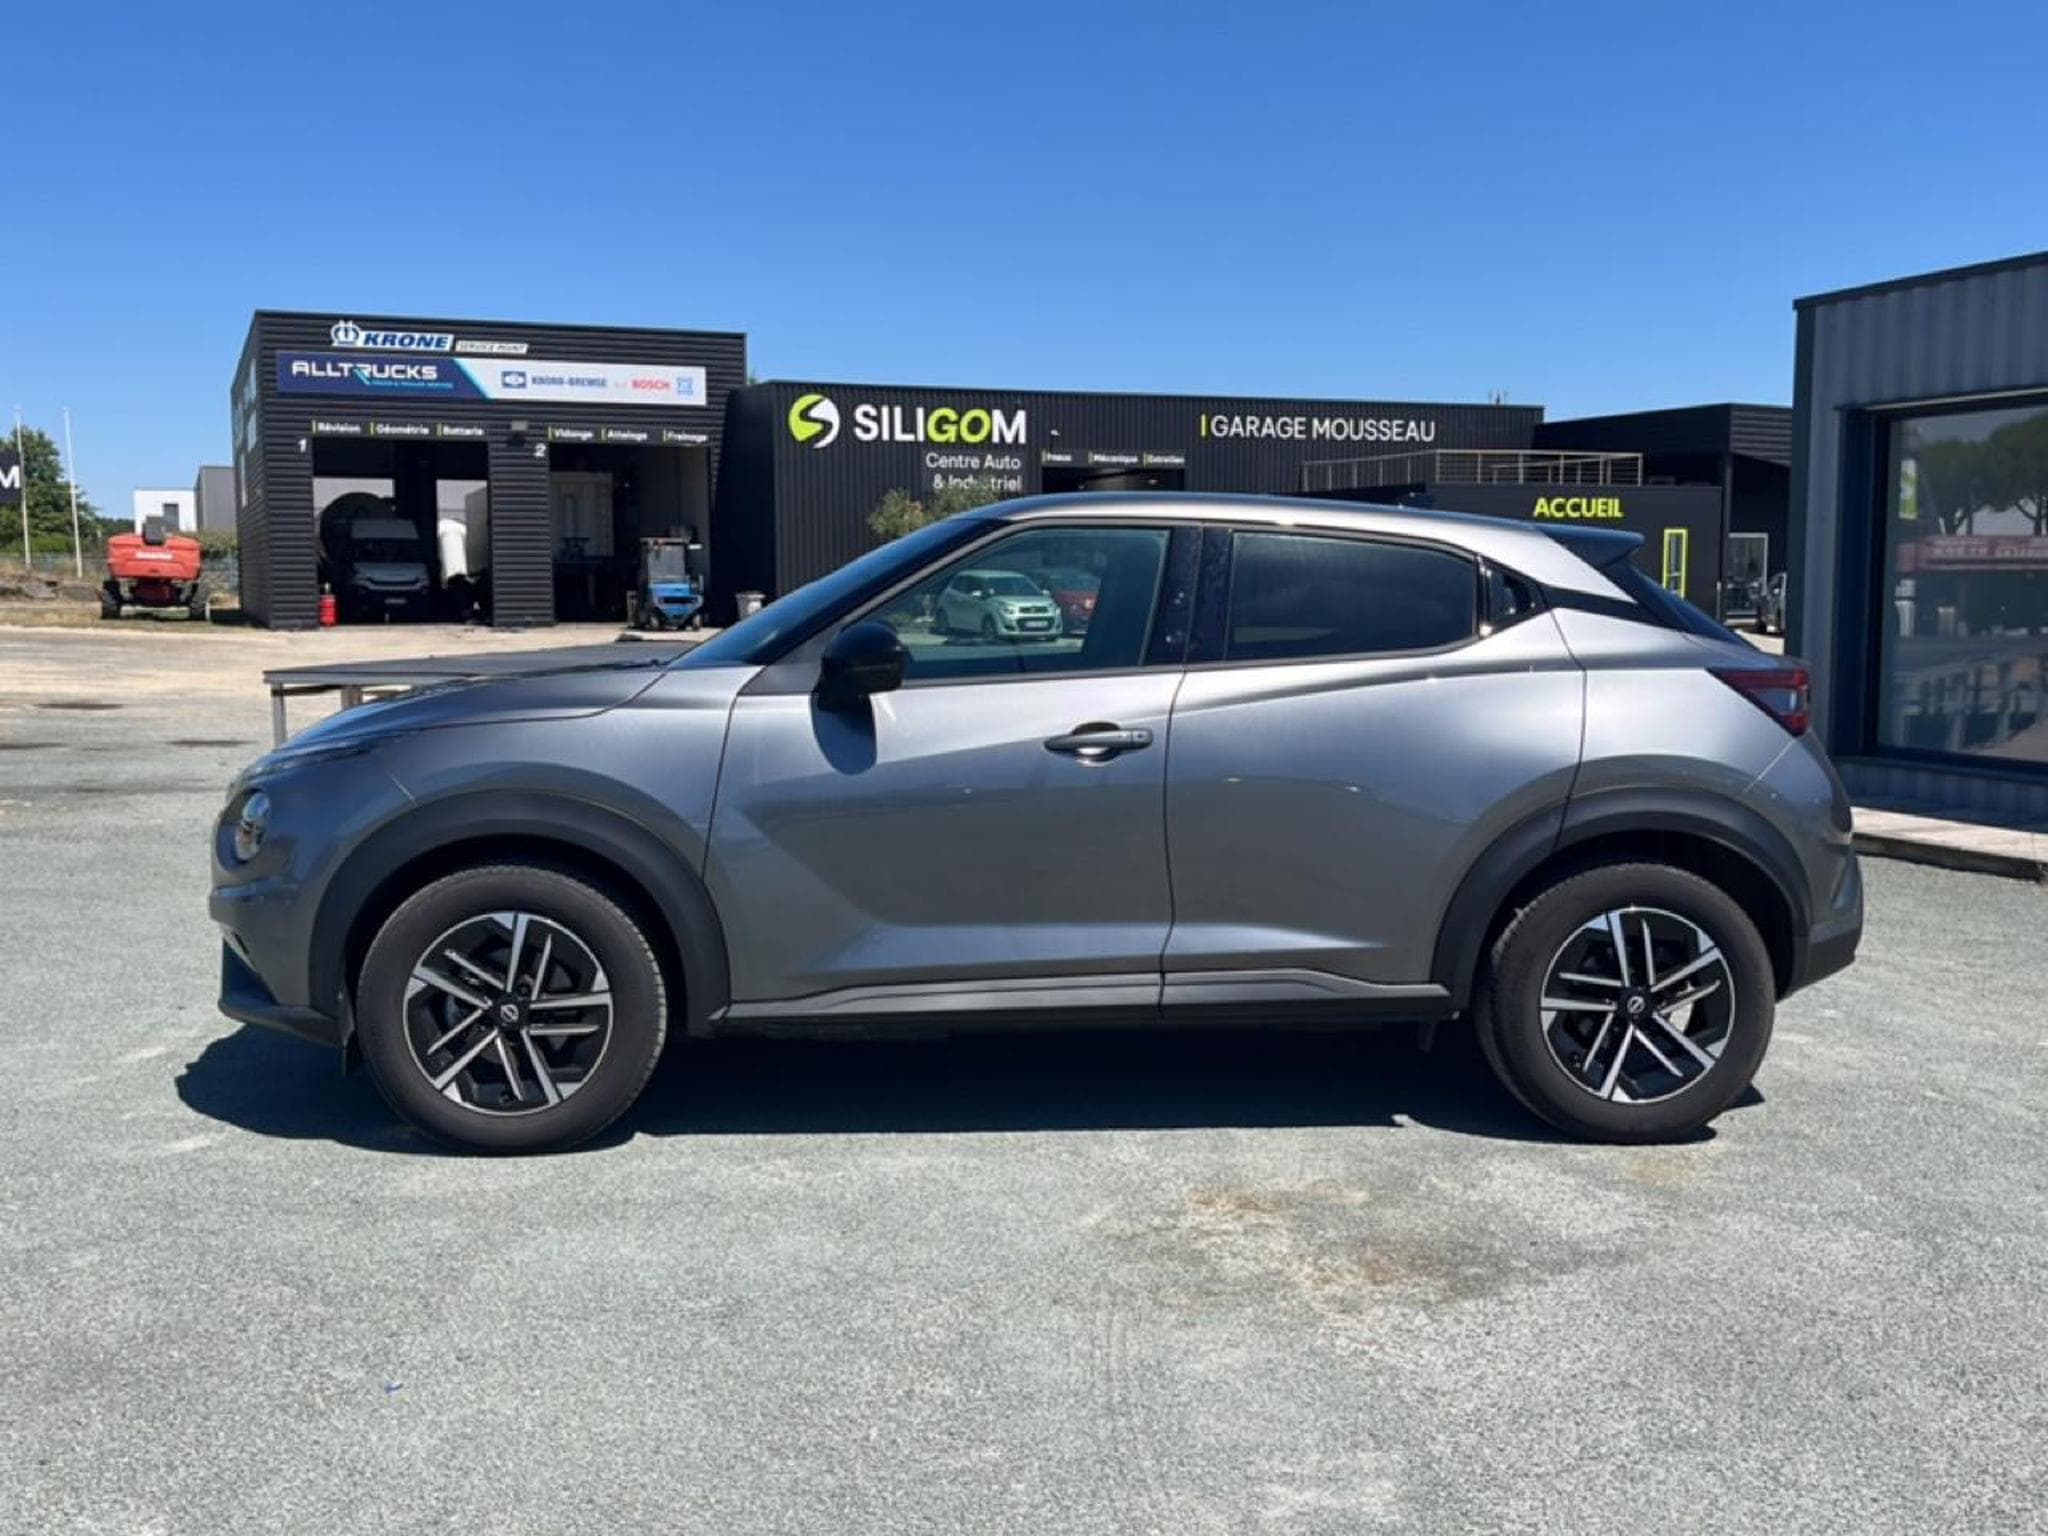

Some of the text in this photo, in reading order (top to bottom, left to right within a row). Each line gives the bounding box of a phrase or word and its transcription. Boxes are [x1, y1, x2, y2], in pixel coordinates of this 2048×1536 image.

[364, 332, 449, 348] KRONE
[292, 361, 438, 380] ALLTRUCKS
[853, 404, 1028, 445] SILIGOM
[1210, 414, 1436, 442] GARAGE MOUSSEAU
[298, 437, 307, 453] 1
[534, 443, 547, 457] 2
[926, 452, 1022, 470] Centre Auto
[933, 473, 1022, 492] & Indtriel
[1533, 497, 1624, 518] ACCUEIL
